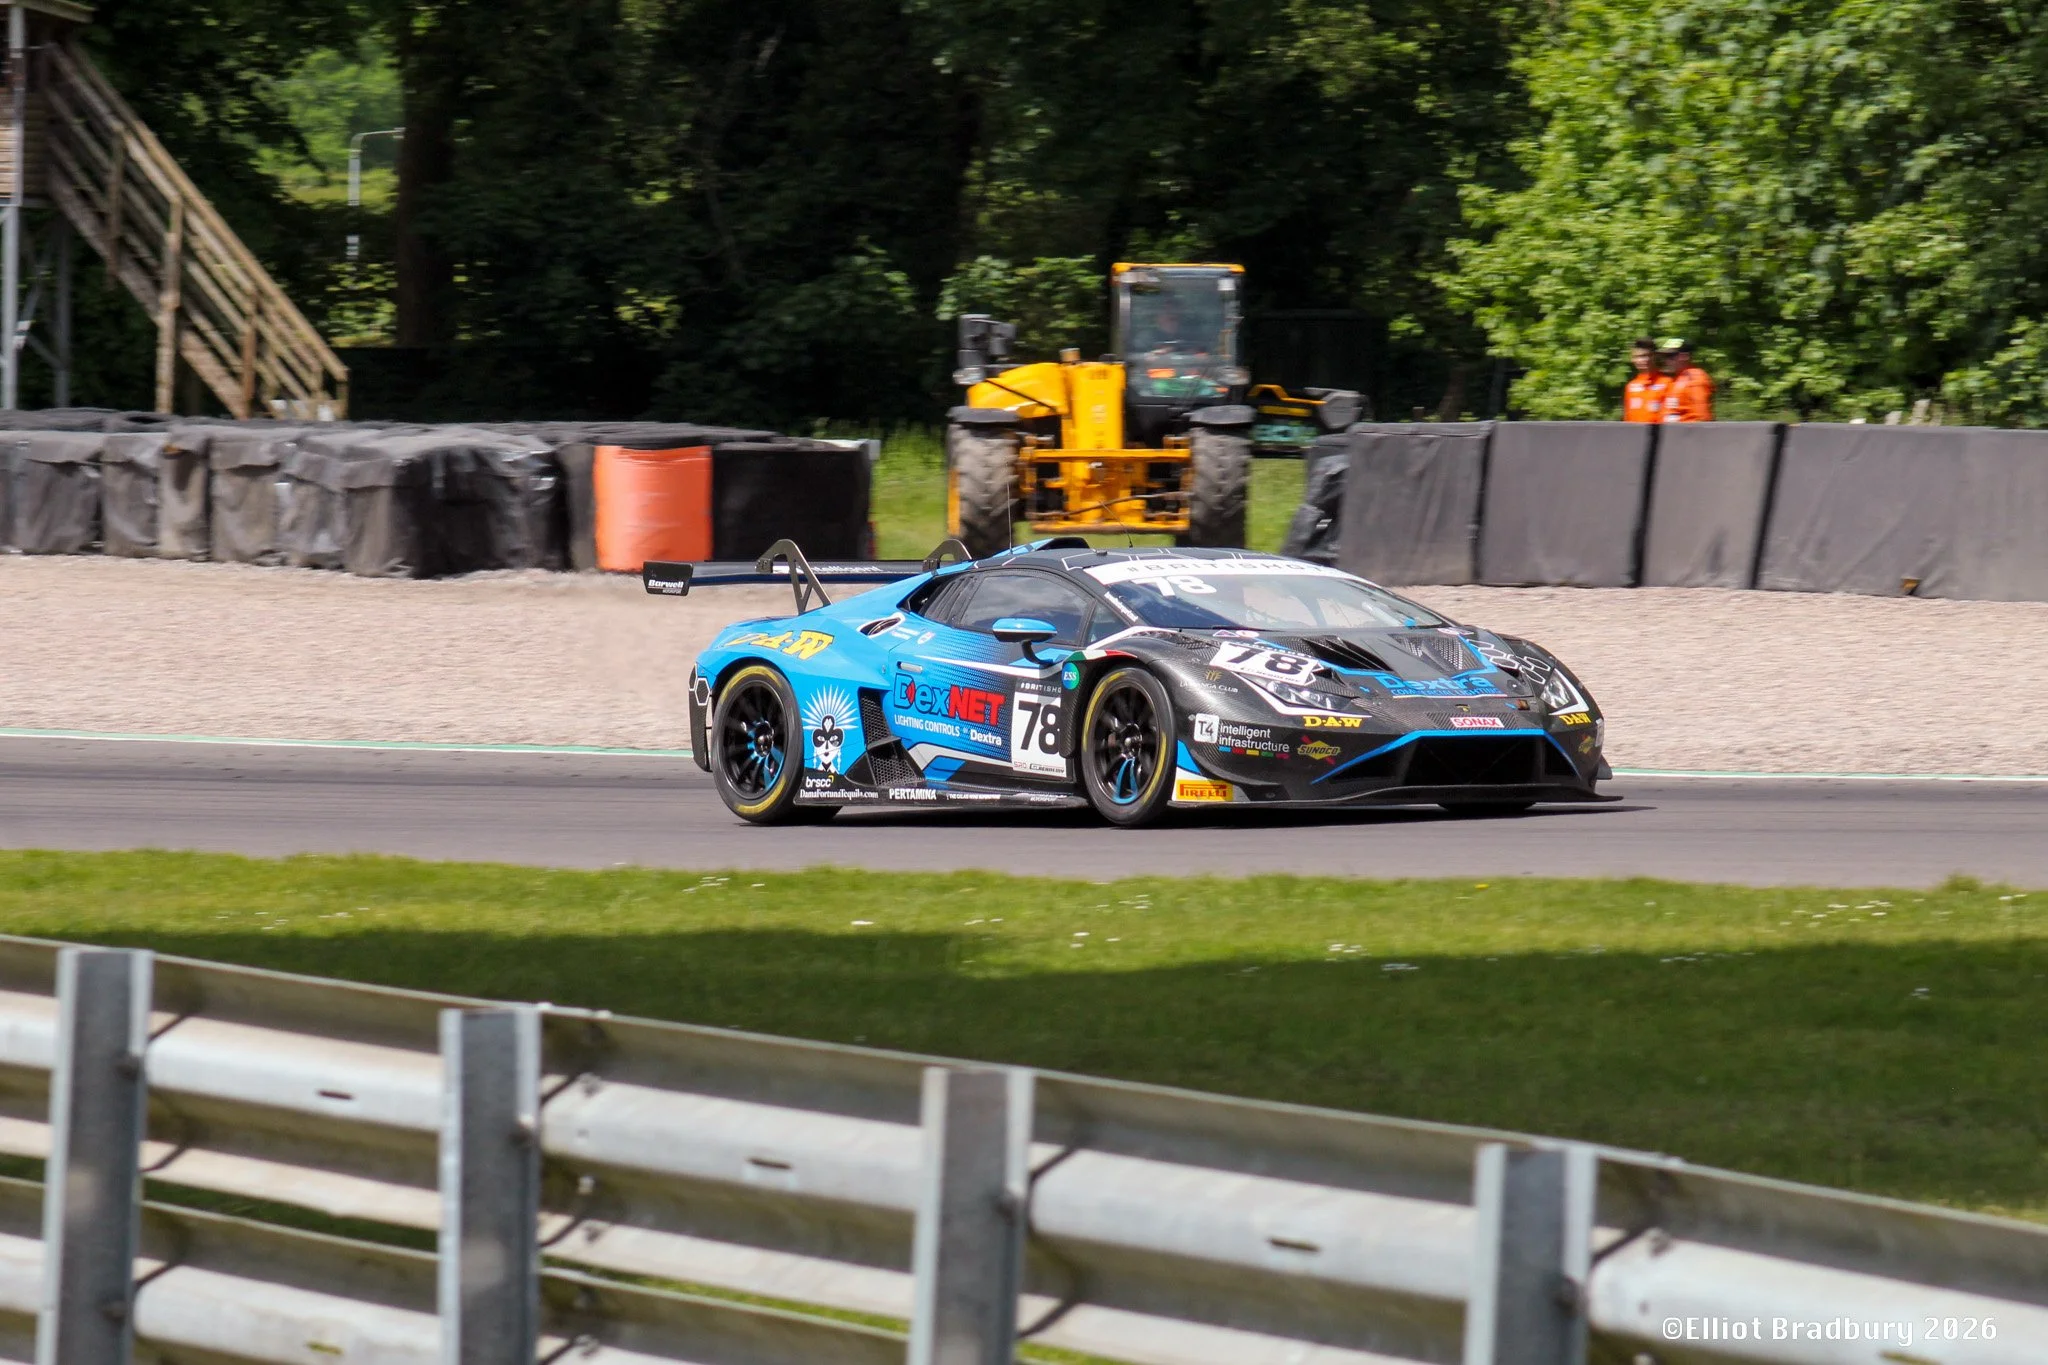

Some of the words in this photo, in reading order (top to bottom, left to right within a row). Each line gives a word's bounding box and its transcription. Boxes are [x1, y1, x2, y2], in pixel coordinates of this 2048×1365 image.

[648, 579, 684, 588] Barwell
[1131, 575, 1217, 597] 78
[1226, 643, 1309, 675] 78
[1063, 671, 1077, 681] ESS
[1376, 675, 1495, 690] Dextra
[893, 673, 1006, 727] DexNET
[894, 714, 924, 730] LIGHTING
[924, 719, 960, 737] CONTROLS
[970, 728, 1002, 746] Dextra
[1018, 699, 1062, 755] 78
[1198, 720, 1214, 738] T4
[1453, 718, 1499, 728] SONAX
[1220, 724, 1271, 740] intelligent
[1219, 735, 1290, 753] infrastructure
[1298, 746, 1339, 756] SUNOCO
[805, 775, 832, 788] brscc
[888, 788, 937, 800] PERTAMINA
[1179, 782, 1227, 798] PIRELLI
